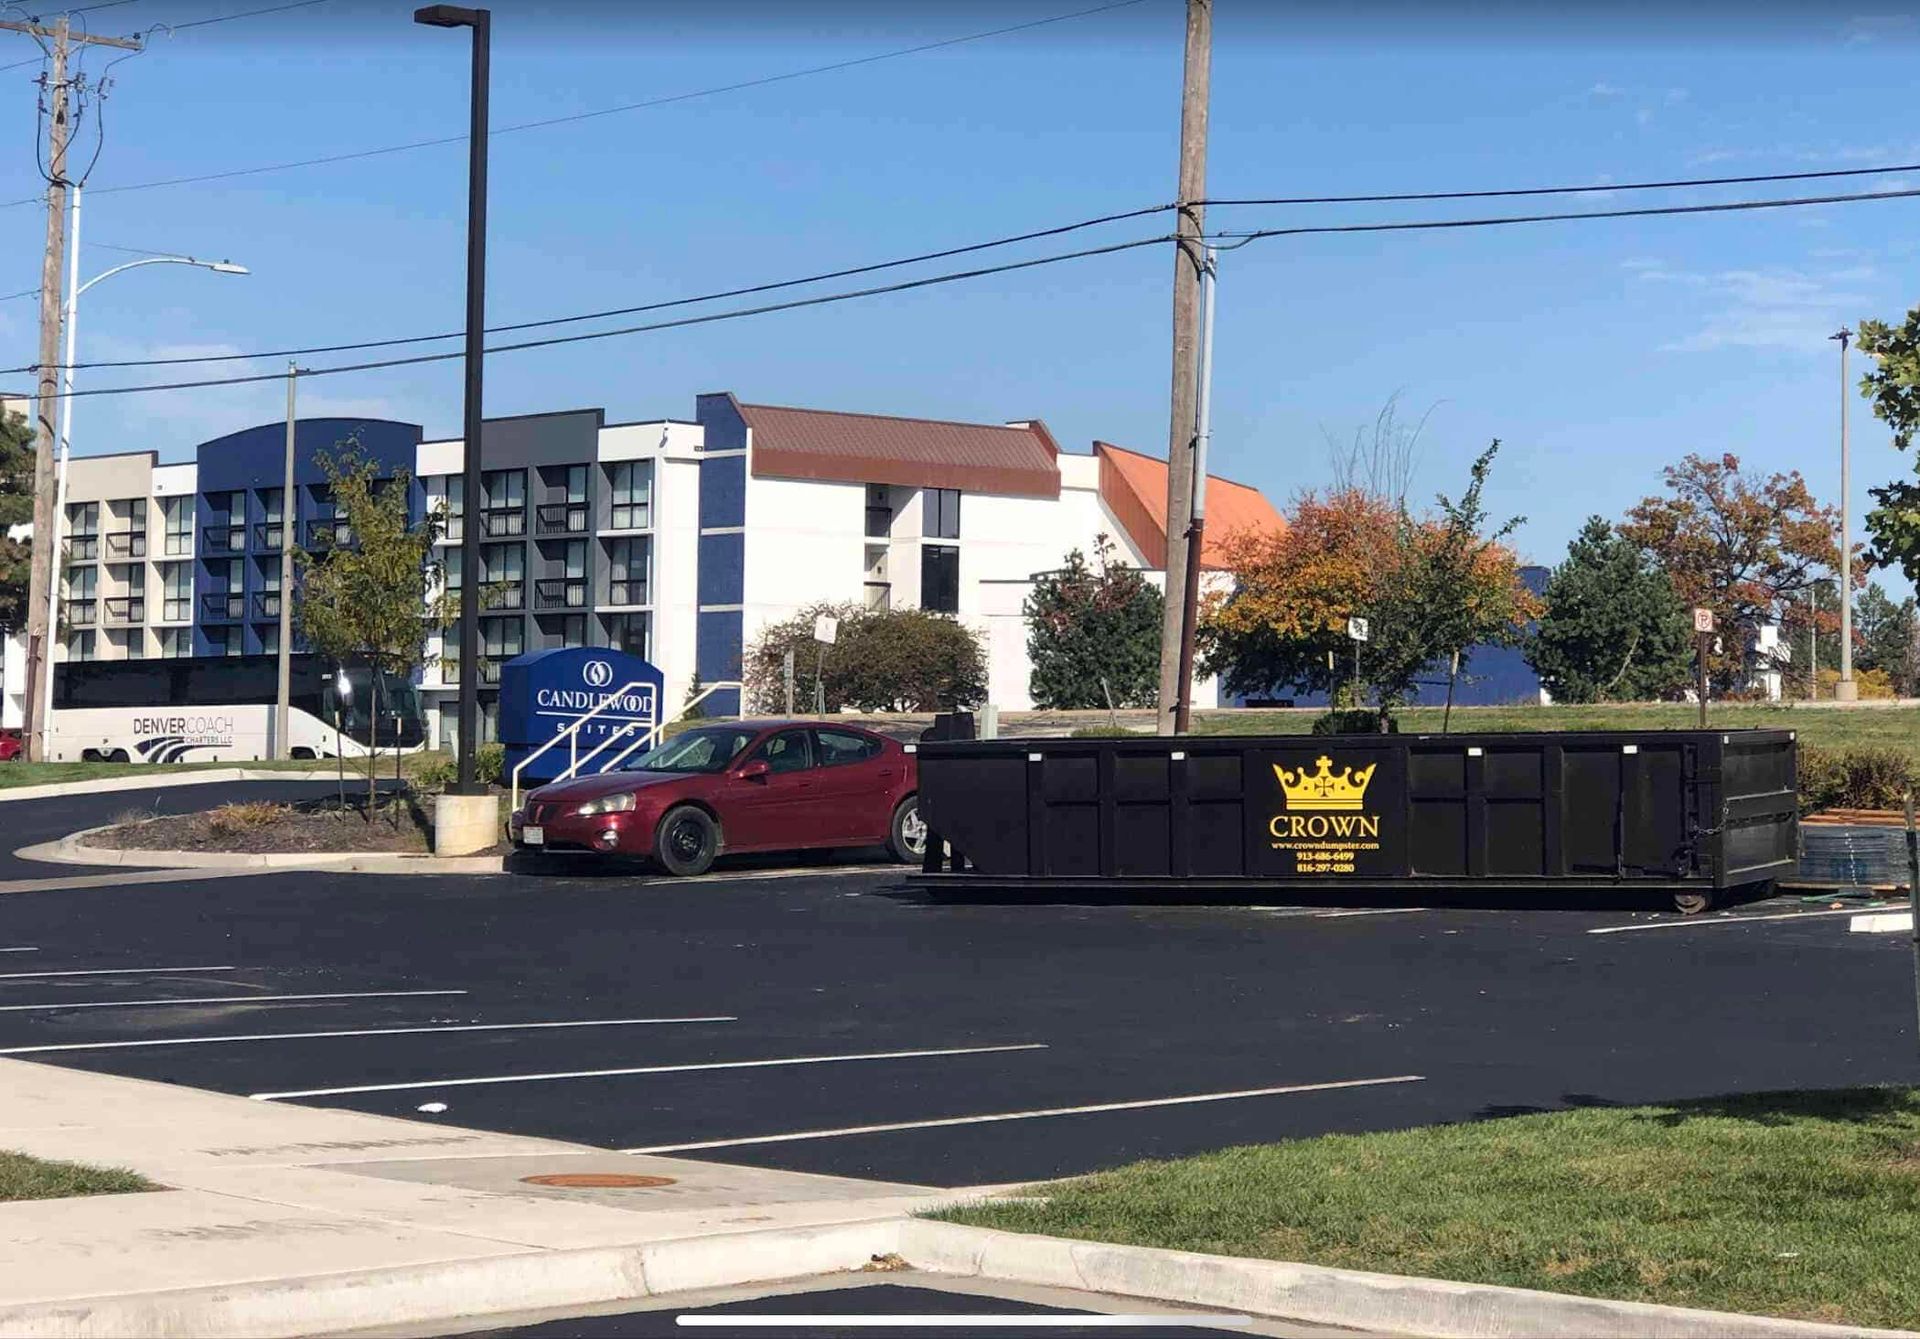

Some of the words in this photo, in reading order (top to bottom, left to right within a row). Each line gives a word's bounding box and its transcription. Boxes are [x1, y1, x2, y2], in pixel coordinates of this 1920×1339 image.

[538, 689, 653, 713] CANDLEWOOD
[186, 736, 219, 744] CHARTERS
[220, 736, 233, 744] LLC
[1269, 815, 1380, 838] CROWN
[1271, 841, 1380, 851] www.crowndumpster.com
